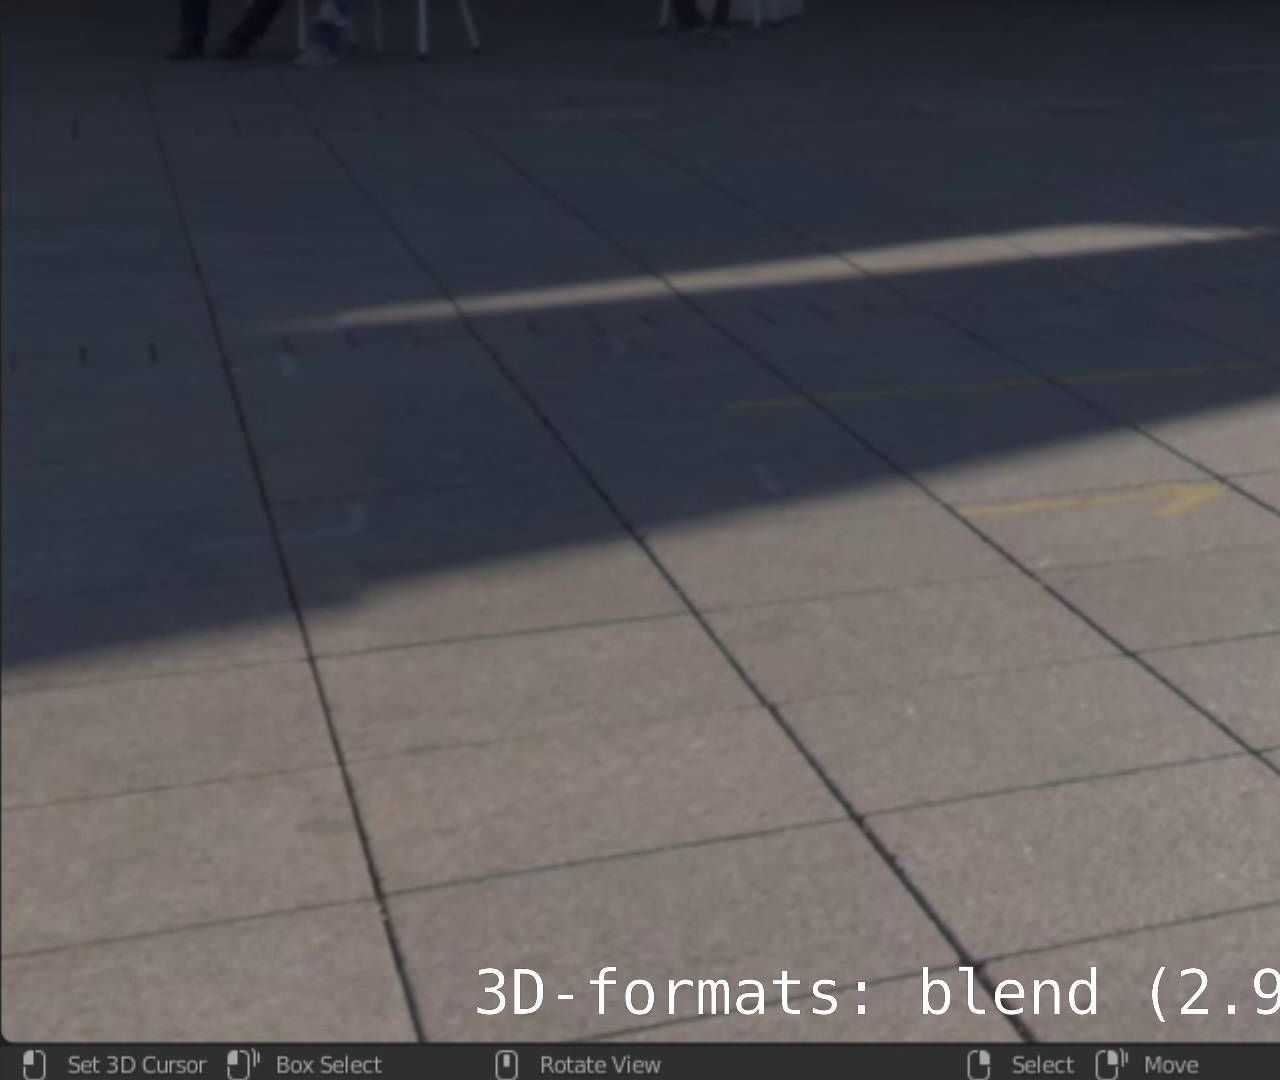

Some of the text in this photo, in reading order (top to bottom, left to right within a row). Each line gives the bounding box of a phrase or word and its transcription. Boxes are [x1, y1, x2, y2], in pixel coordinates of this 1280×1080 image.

[68, 1055, 207, 1074] Set 3D Cursor
[277, 1055, 382, 1074] Box Select
[541, 1055, 661, 1074] Rotate View
[1012, 1055, 1074, 1074] Select
[1145, 1055, 1199, 1074] Move
